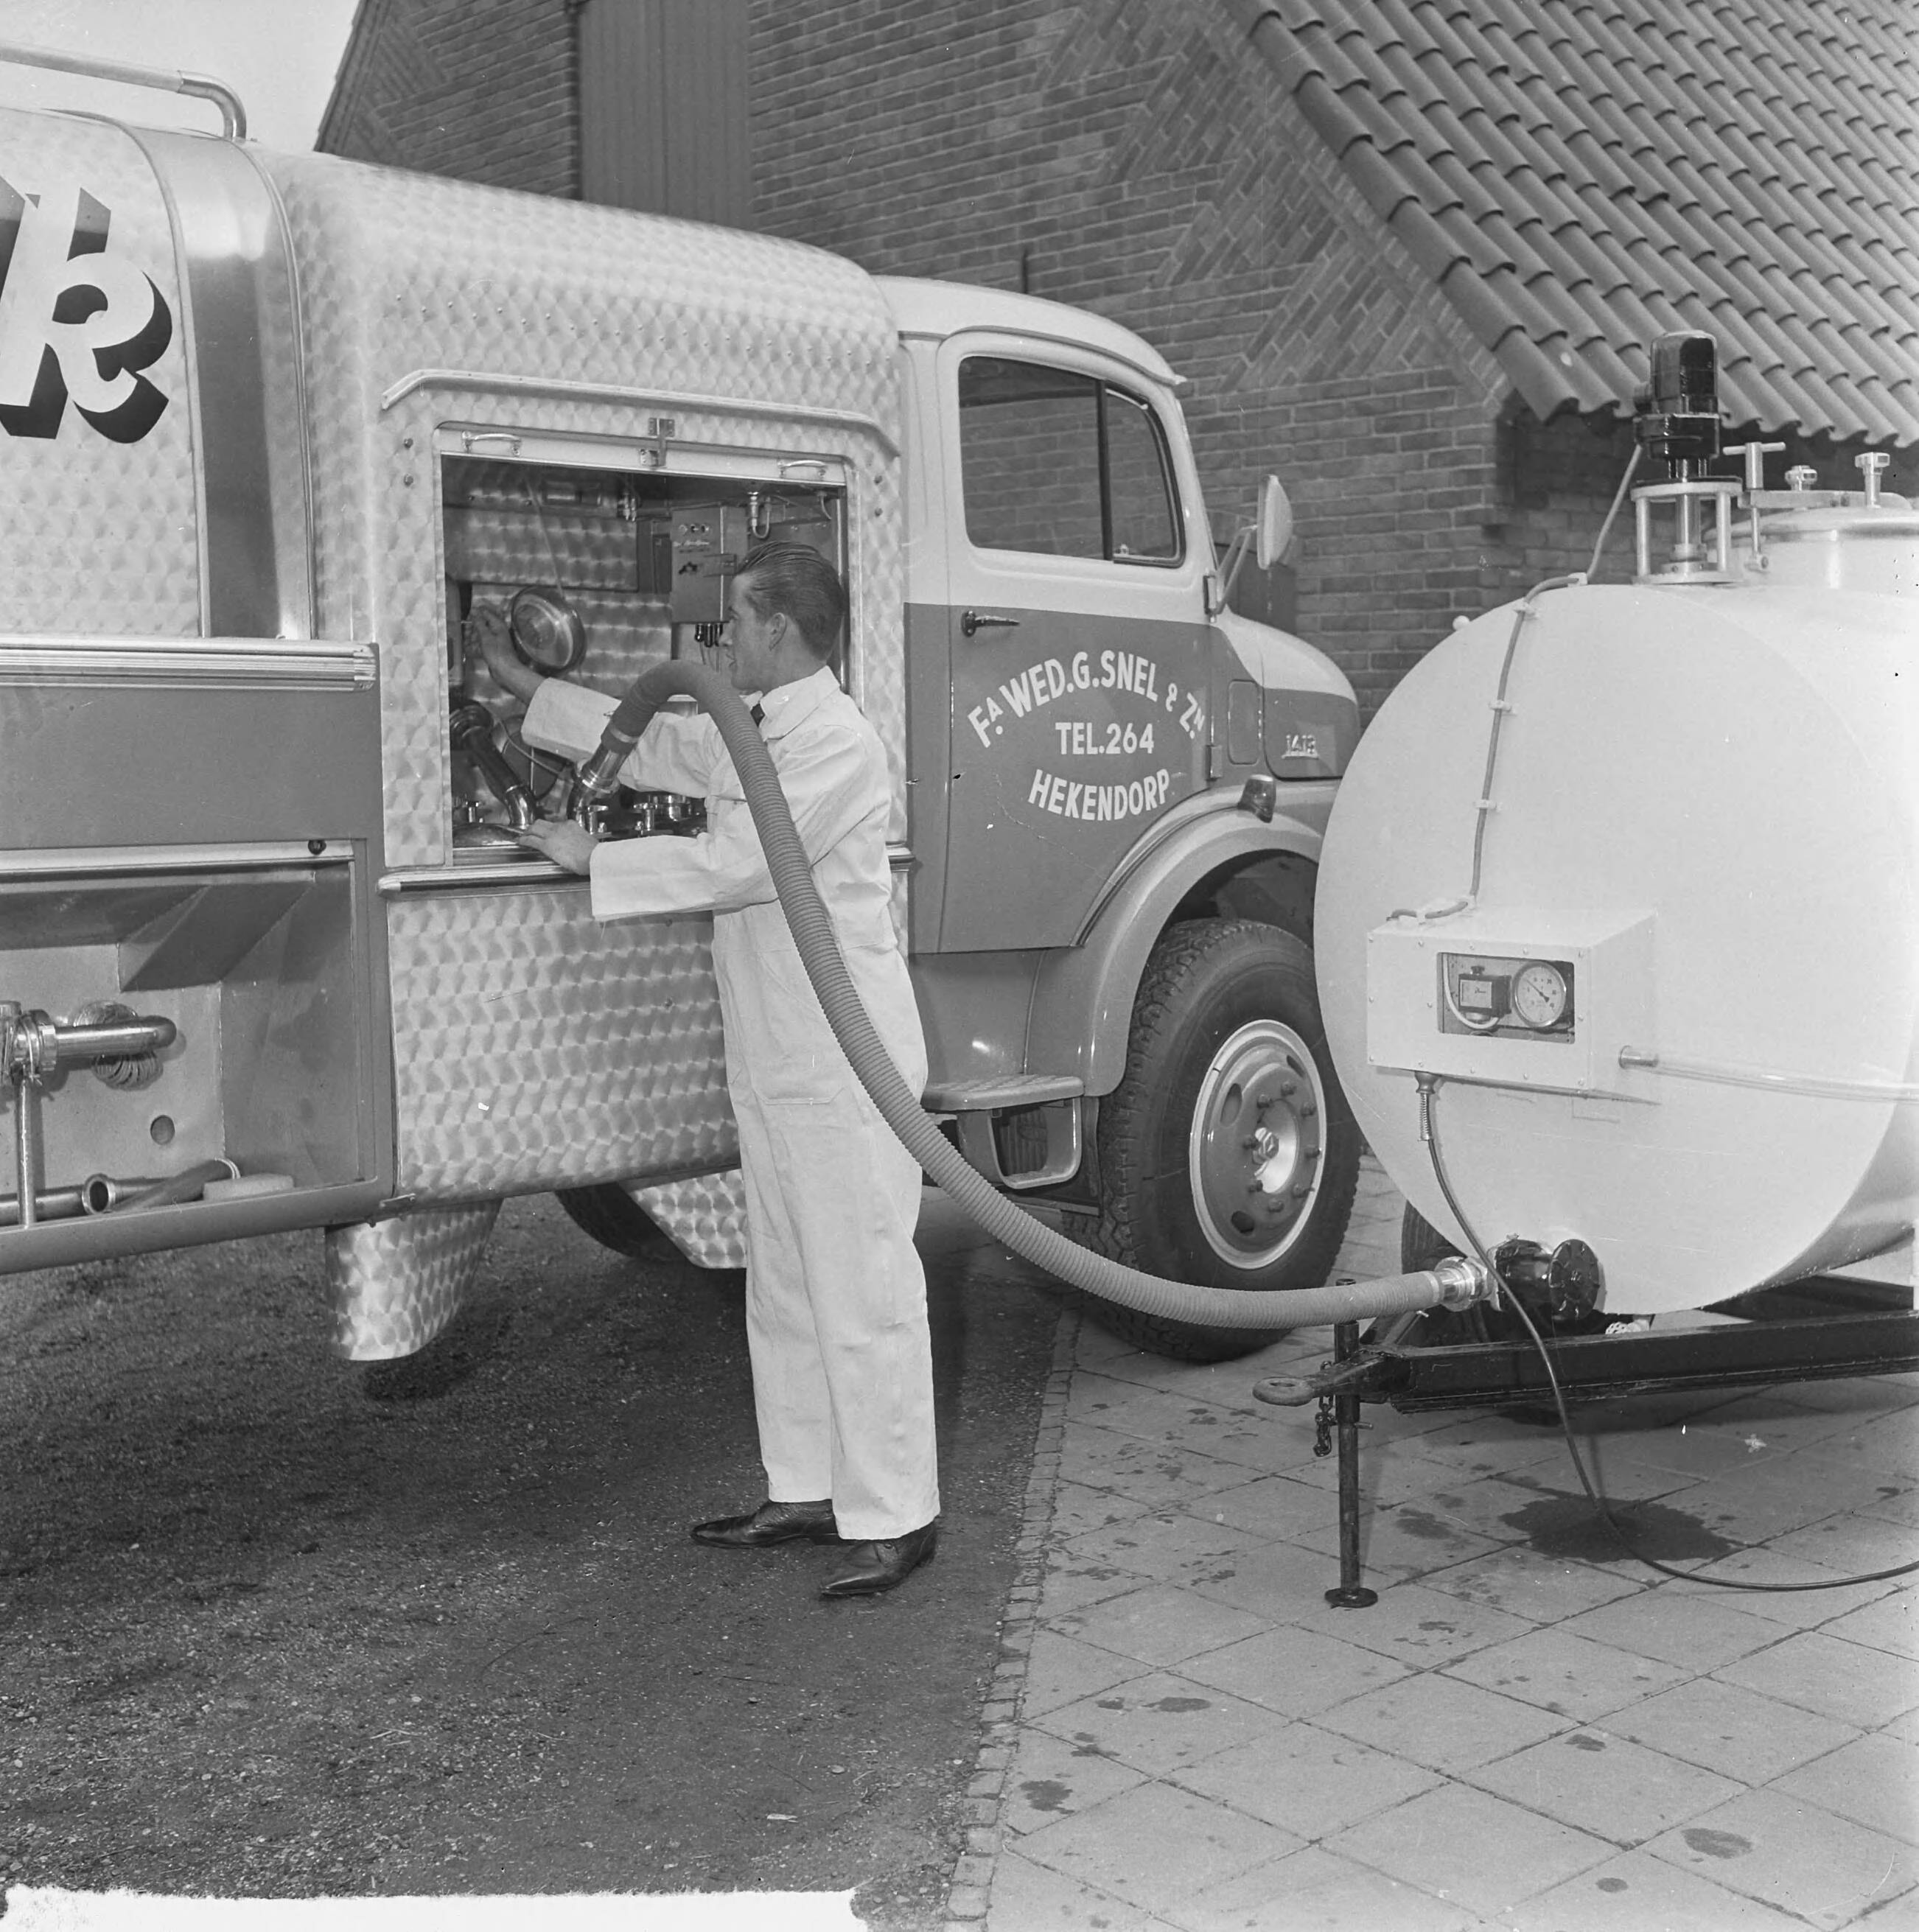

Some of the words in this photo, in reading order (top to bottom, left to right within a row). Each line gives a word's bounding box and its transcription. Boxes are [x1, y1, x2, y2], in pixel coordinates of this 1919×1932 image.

[1165, 683, 1178, 713] &
[1055, 721, 1155, 755] TEL.264
[1027, 769, 1170, 821] HEKENDORP
